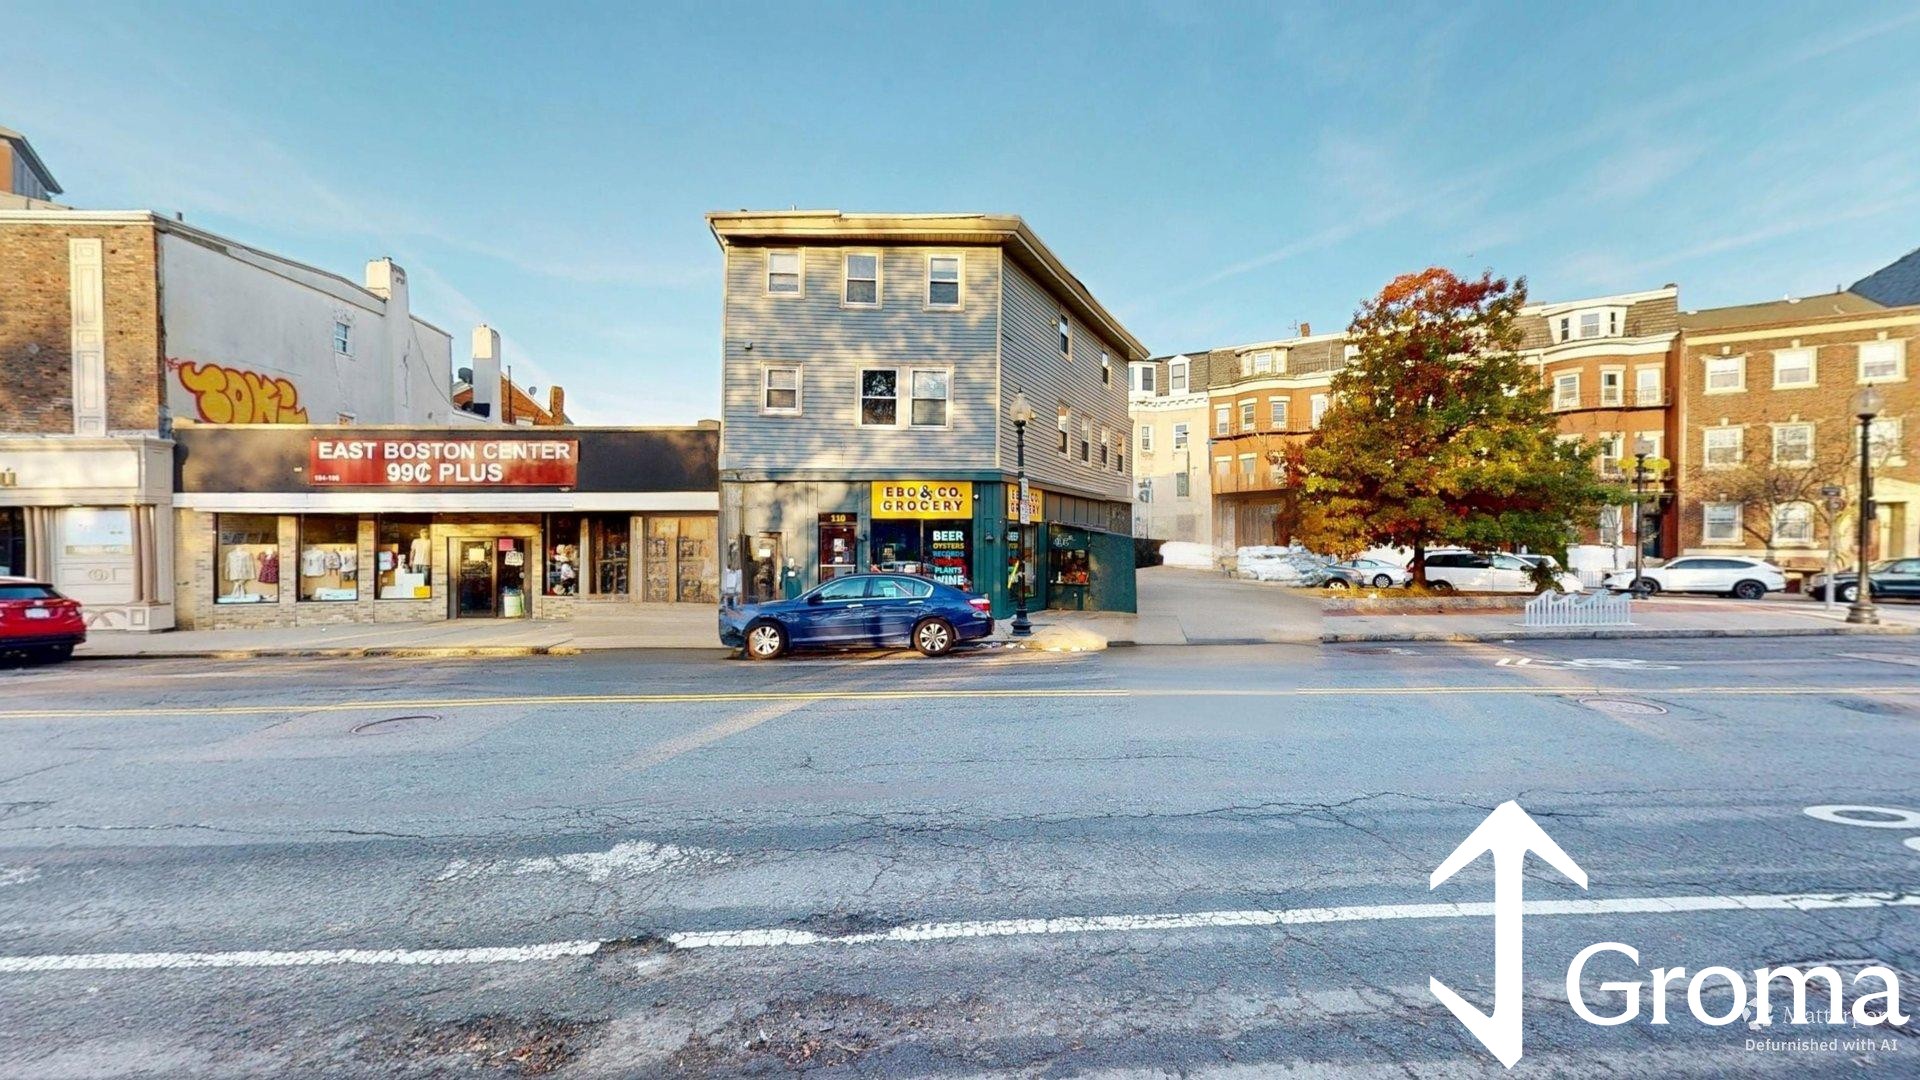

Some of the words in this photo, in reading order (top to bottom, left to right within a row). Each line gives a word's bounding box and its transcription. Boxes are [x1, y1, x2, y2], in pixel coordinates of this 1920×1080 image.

[318, 441, 378, 460] EAST
[384, 441, 476, 460] BOSTON
[482, 441, 570, 460] CENTER
[386, 462, 431, 482] 99¢
[439, 463, 502, 482] PLUS
[886, 487, 916, 497] EBO
[920, 485, 932, 500] &
[938, 487, 963, 497] CO.
[883, 501, 962, 511] GROCERY
[831, 514, 846, 523] 110
[933, 530, 964, 541] BEER
[933, 542, 965, 550] OYSTERS
[934, 575, 964, 585] WINE
